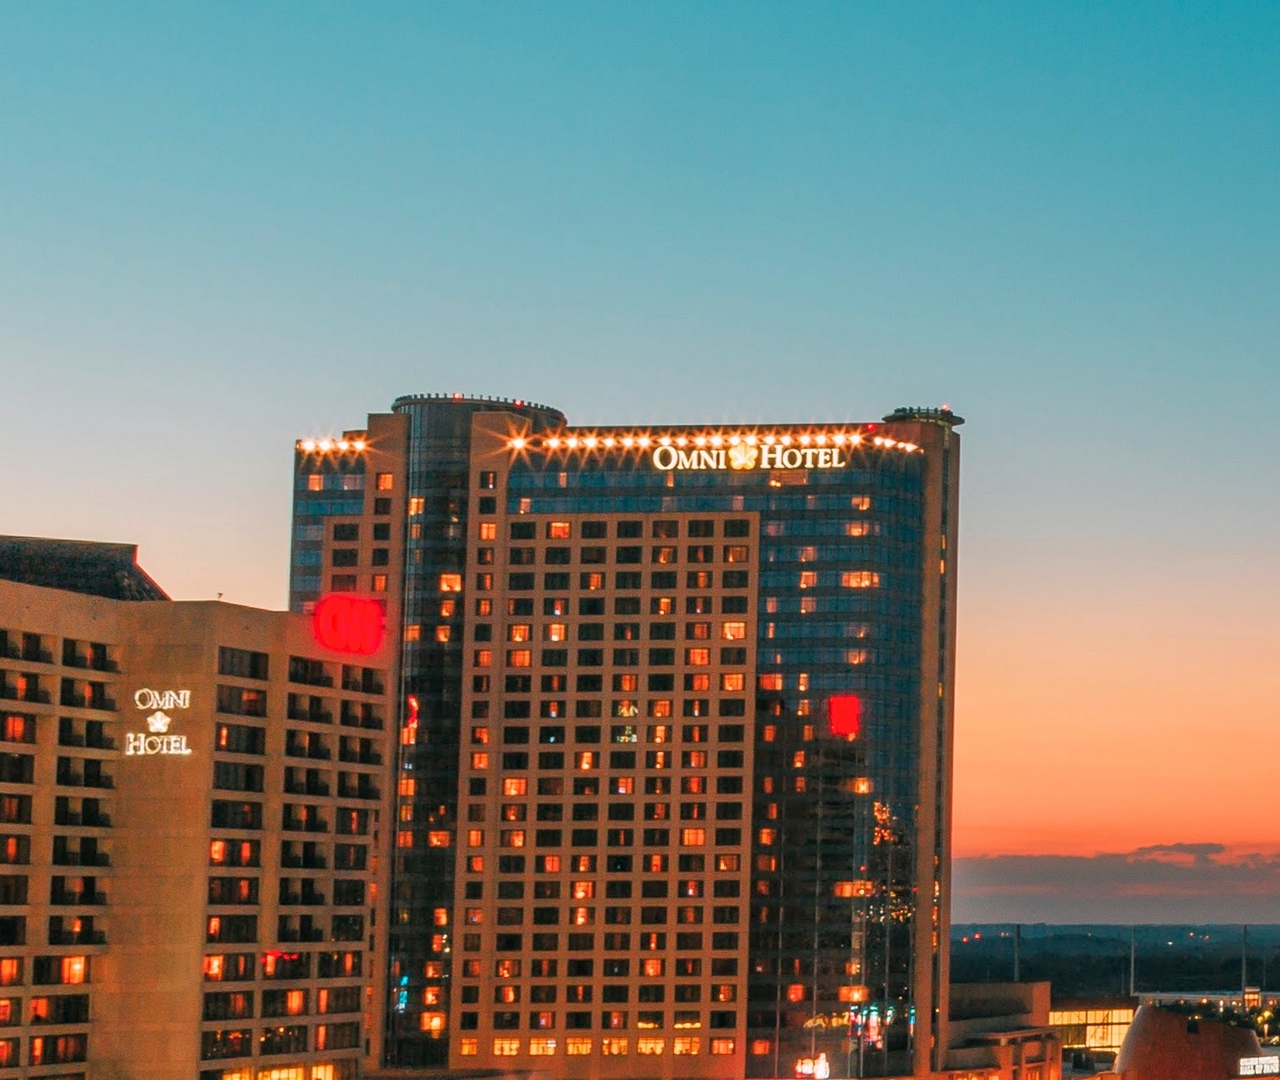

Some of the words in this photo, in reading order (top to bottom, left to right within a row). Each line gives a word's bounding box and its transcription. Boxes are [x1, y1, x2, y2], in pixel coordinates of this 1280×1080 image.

[653, 445, 727, 470] OMNI
[759, 444, 846, 469] HOTEL
[134, 688, 191, 710] OMNI
[125, 732, 192, 755] HOTEL
